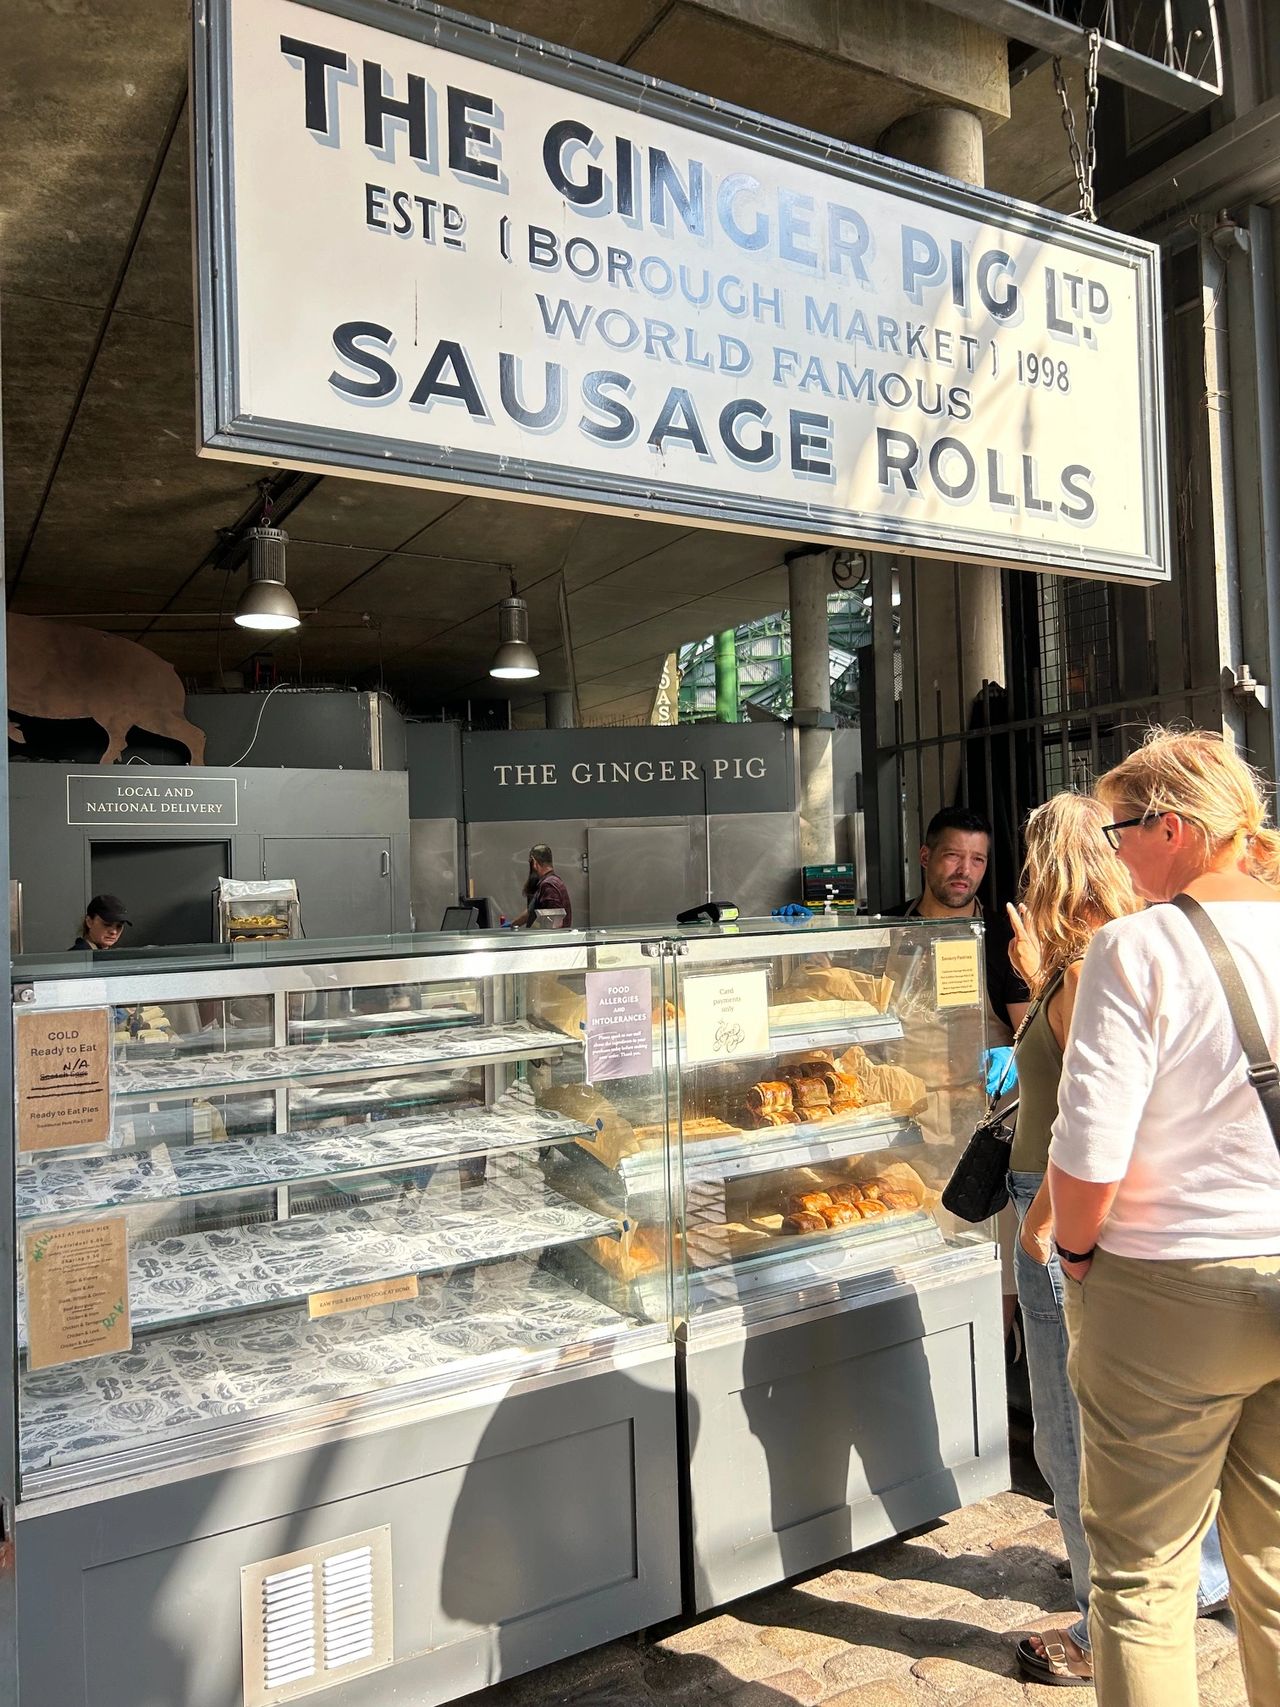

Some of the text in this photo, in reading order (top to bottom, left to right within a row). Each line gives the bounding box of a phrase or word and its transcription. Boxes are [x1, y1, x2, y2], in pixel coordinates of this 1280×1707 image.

[279, 34, 509, 194] THE
[543, 119, 873, 290] GINGER
[900, 224, 1024, 323] PIG
[535, 294, 973, 423] WORLD FAMOUS
[1017, 349, 1070, 394] 1998
[328, 321, 1097, 526] SAUSAGE ROLLS
[493, 757, 767, 786] THE GINGER PIG
[118, 787, 194, 797] LOCAL AND
[87, 802, 223, 813] NATIONAL DELIVERY
[608, 985, 630, 994] FOOD
[719, 987, 734, 995] Card
[599, 995, 639, 1006] ALLERGIES
[713, 996, 742, 1007] payments
[721, 1005, 734, 1013] only
[592, 1014, 647, 1026] INTOLERANCES
[47, 1030, 79, 1041] COLD
[30, 1043, 97, 1057] Ready to Eat
[63, 1058, 90, 1071] N/A
[30, 1111, 56, 1120] Ready
[67, 1107, 81, 1116] Eat
[82, 1105, 99, 1113] Pies
